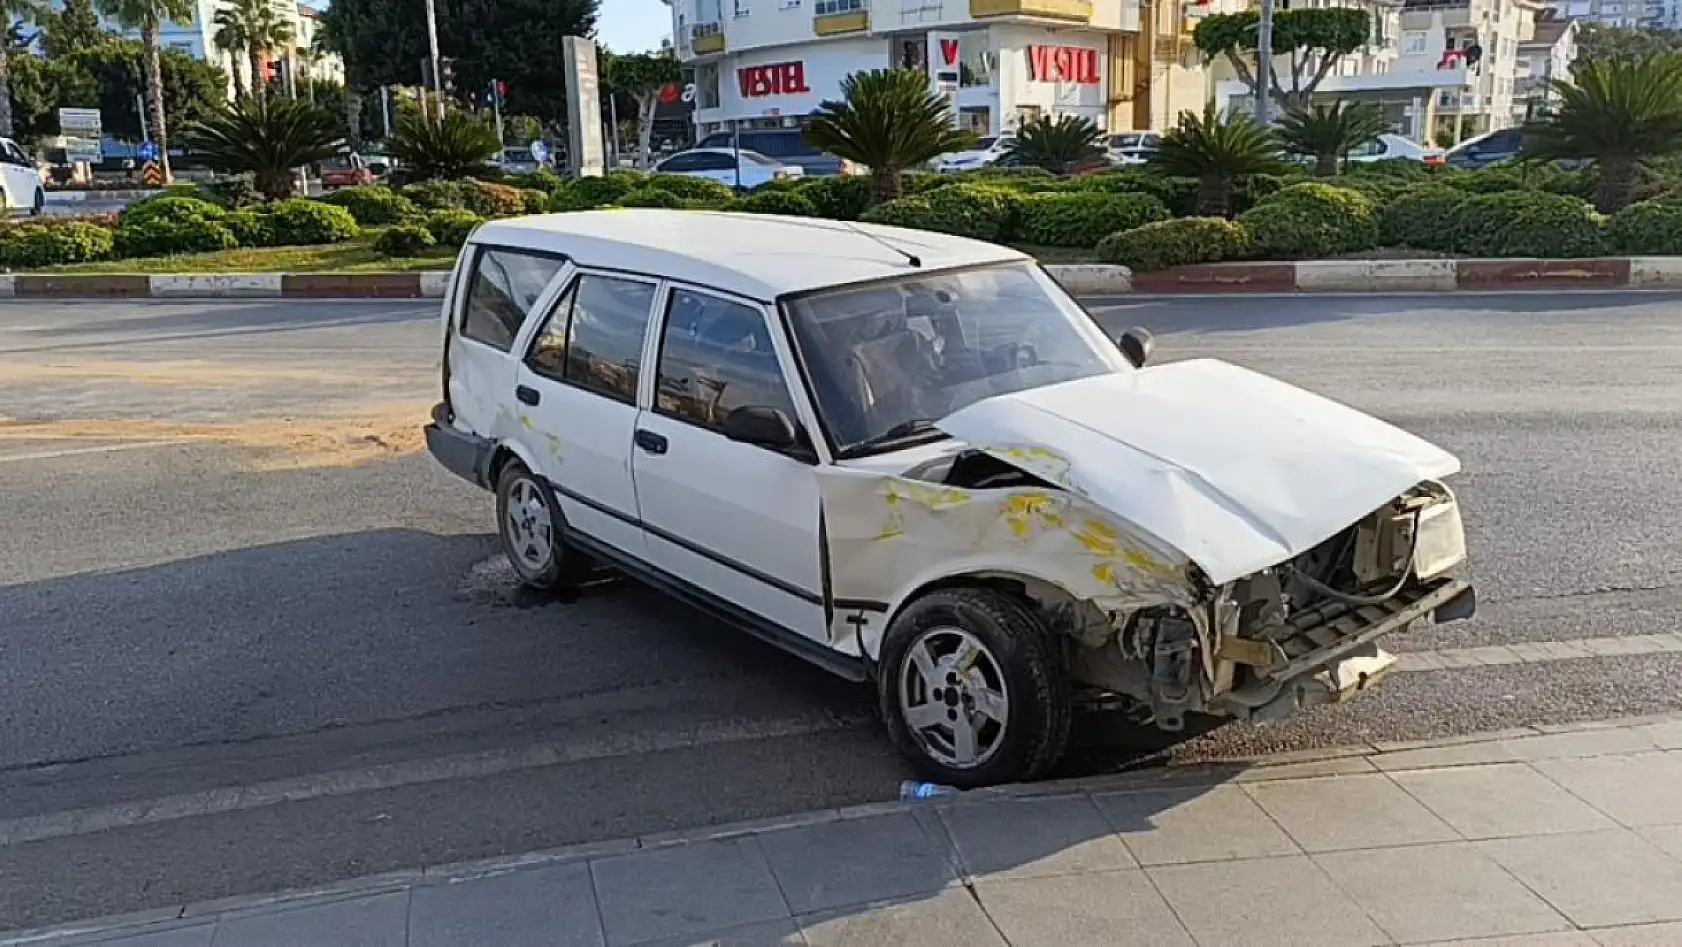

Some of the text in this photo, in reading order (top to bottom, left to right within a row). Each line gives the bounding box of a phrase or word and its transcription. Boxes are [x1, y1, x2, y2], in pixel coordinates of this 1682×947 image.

[940, 38, 959, 66] V
[1026, 44, 1101, 84] VESTEL
[737, 60, 811, 99] VESTEL
